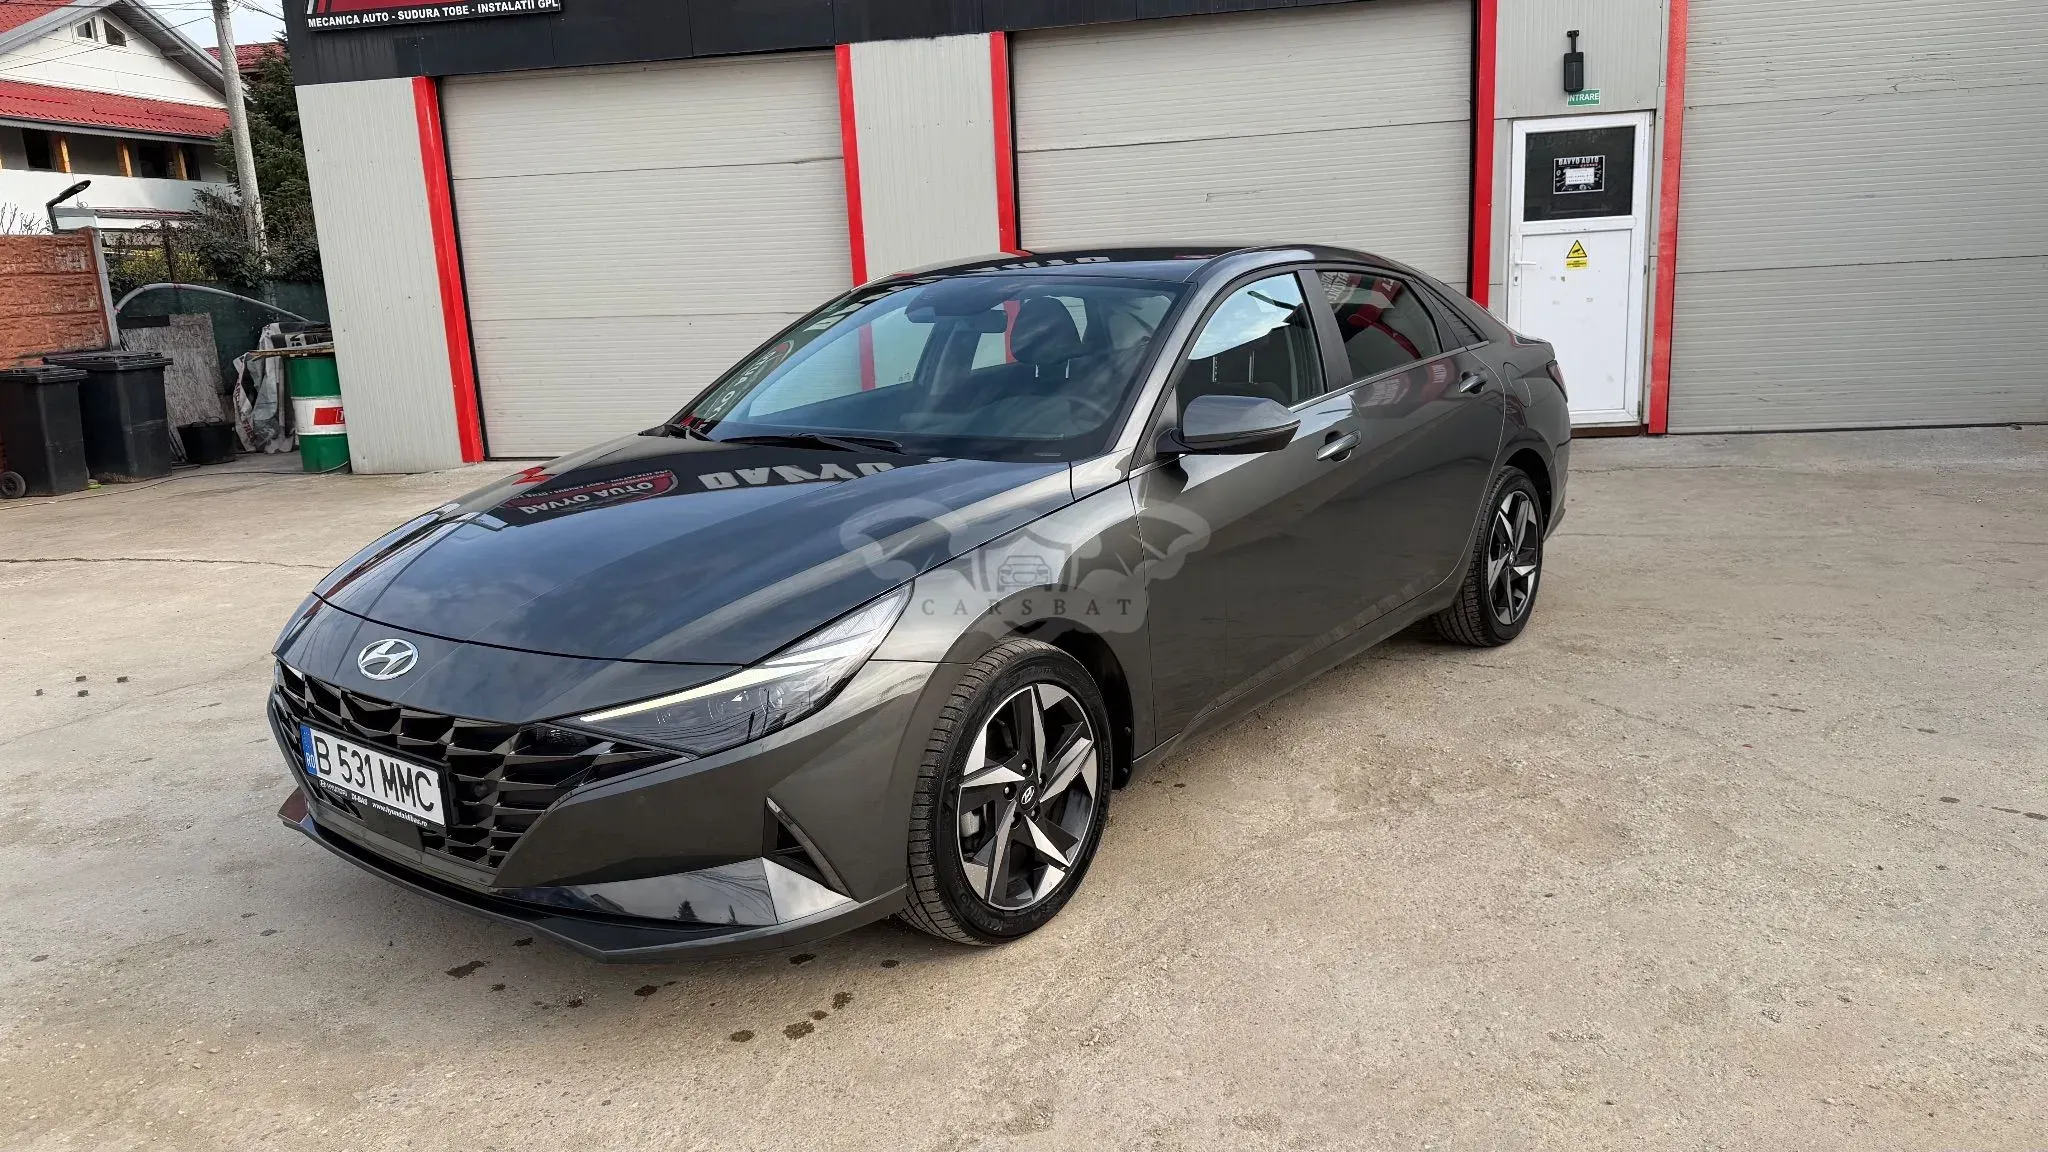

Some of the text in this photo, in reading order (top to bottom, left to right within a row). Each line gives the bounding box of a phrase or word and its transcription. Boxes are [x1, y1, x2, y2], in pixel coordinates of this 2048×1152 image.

[308, 14, 360, 28] MECANICA
[362, 12, 389, 23] AUTO
[397, 8, 440, 20] SUDURA
[442, 5, 469, 17] TOBE
[477, 0, 535, 13] INSTALATII
[538, 0, 559, 9] GPL
[313, 735, 434, 812] B 531 MMC
